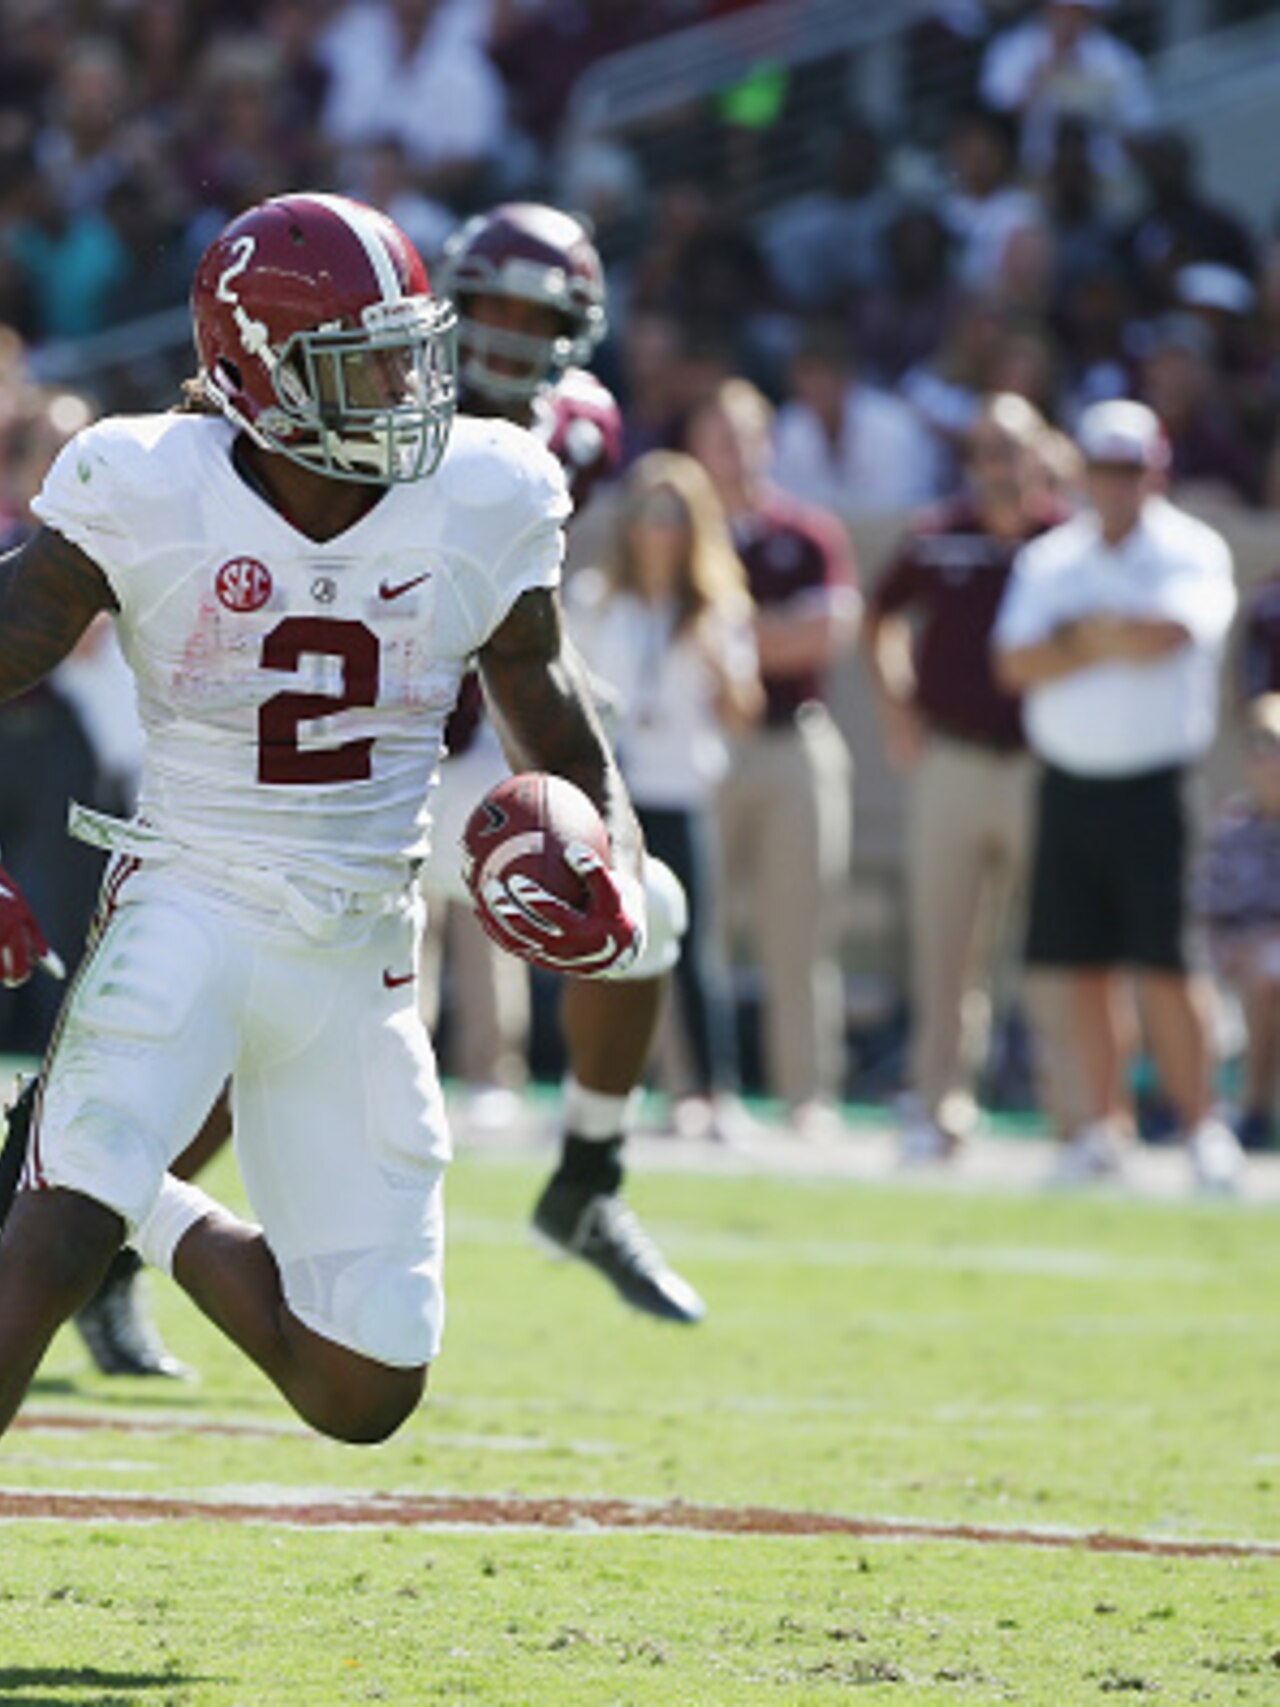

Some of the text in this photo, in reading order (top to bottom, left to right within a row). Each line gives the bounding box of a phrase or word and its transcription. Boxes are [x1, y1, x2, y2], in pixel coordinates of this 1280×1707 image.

[216, 235, 256, 302] 2
[219, 560, 269, 608] SEC
[258, 616, 380, 784] 2
